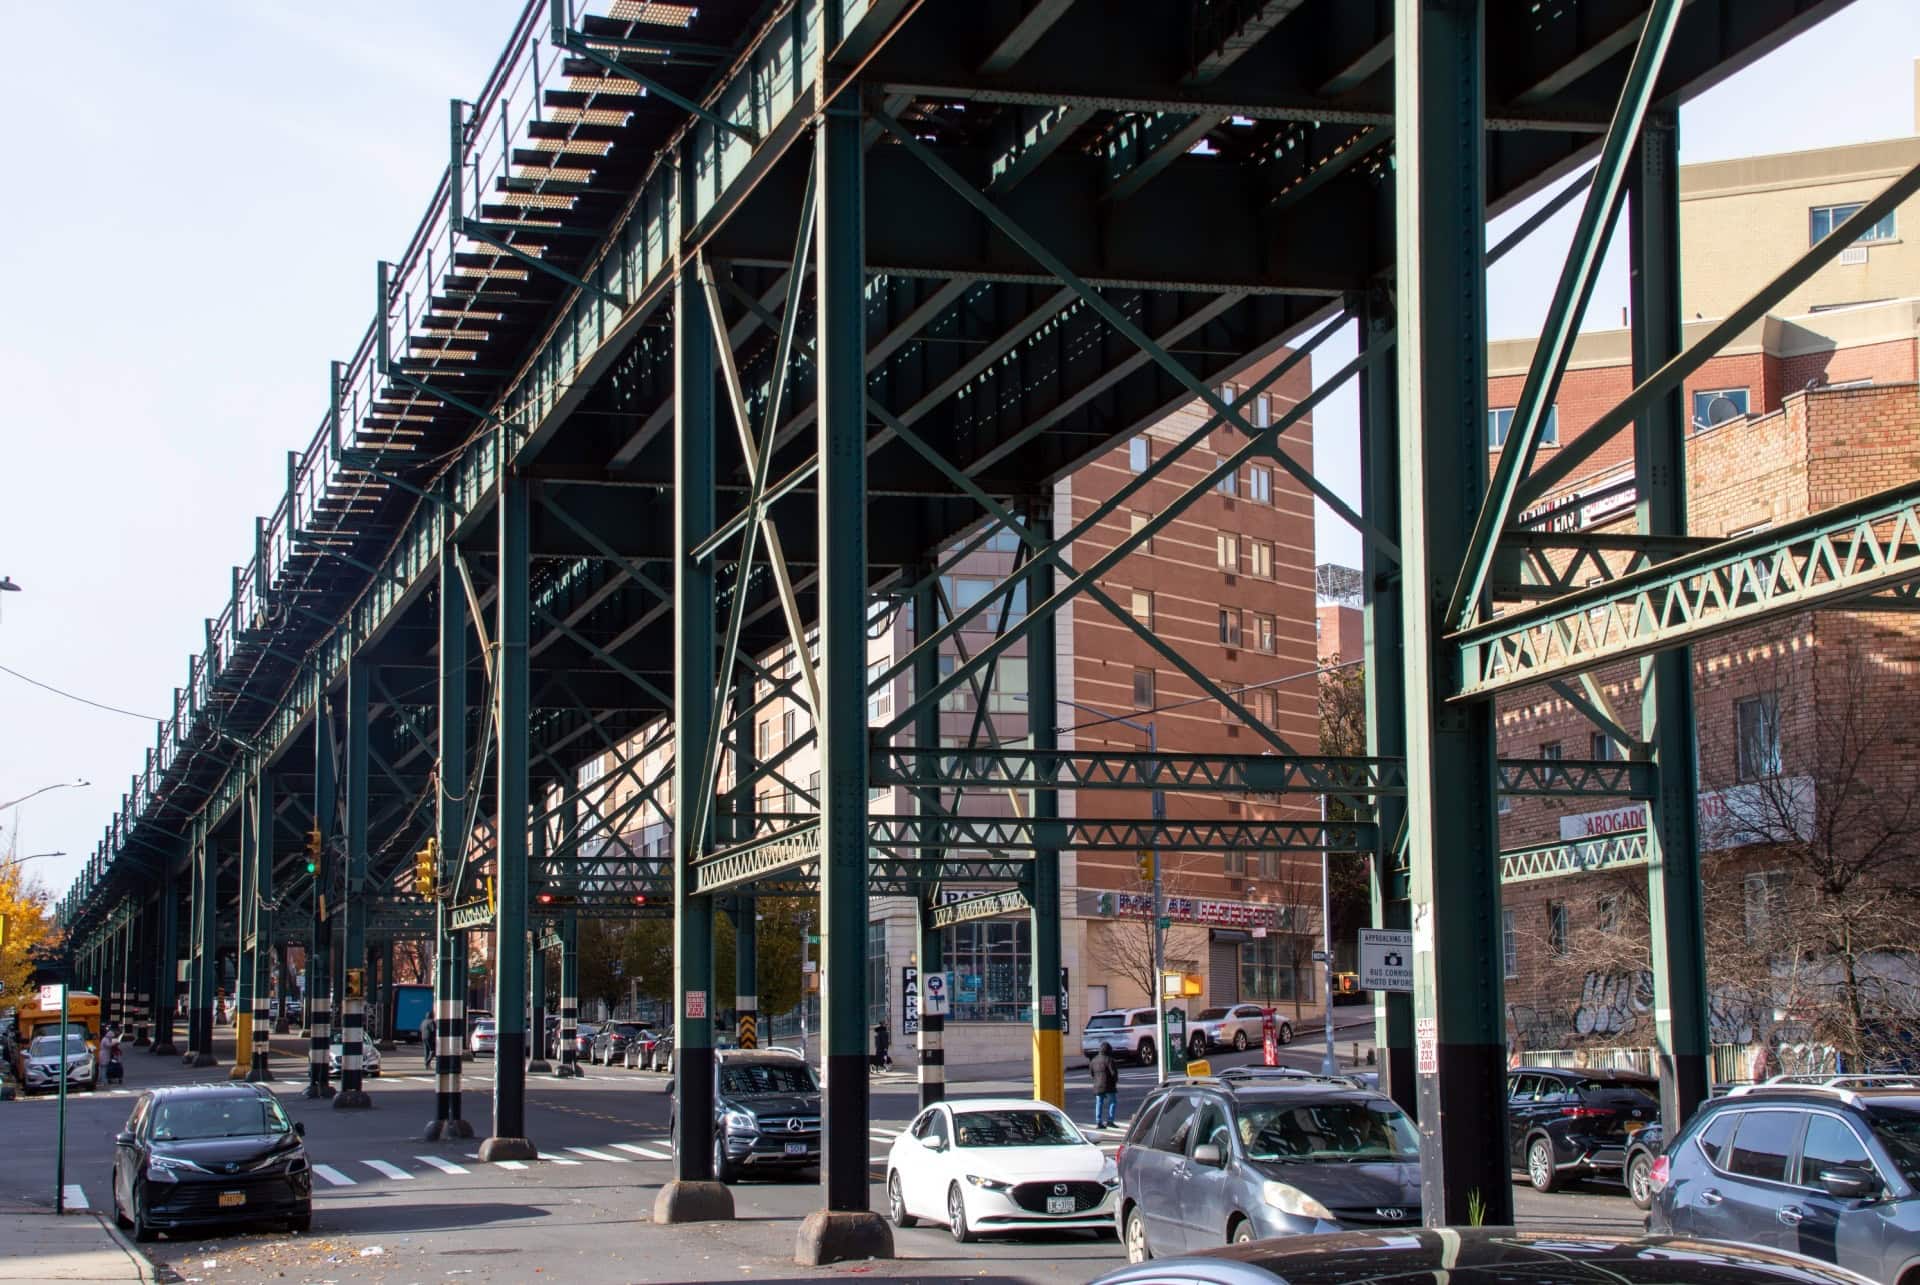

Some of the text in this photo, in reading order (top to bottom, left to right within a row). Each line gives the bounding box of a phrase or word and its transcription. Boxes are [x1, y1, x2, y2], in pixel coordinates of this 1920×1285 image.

[1198, 902, 1276, 928] JACKPOT
[1365, 933, 1402, 943] APPROACHING
[1369, 968, 1382, 976] BUS
[1366, 978, 1386, 986] PHOTO
